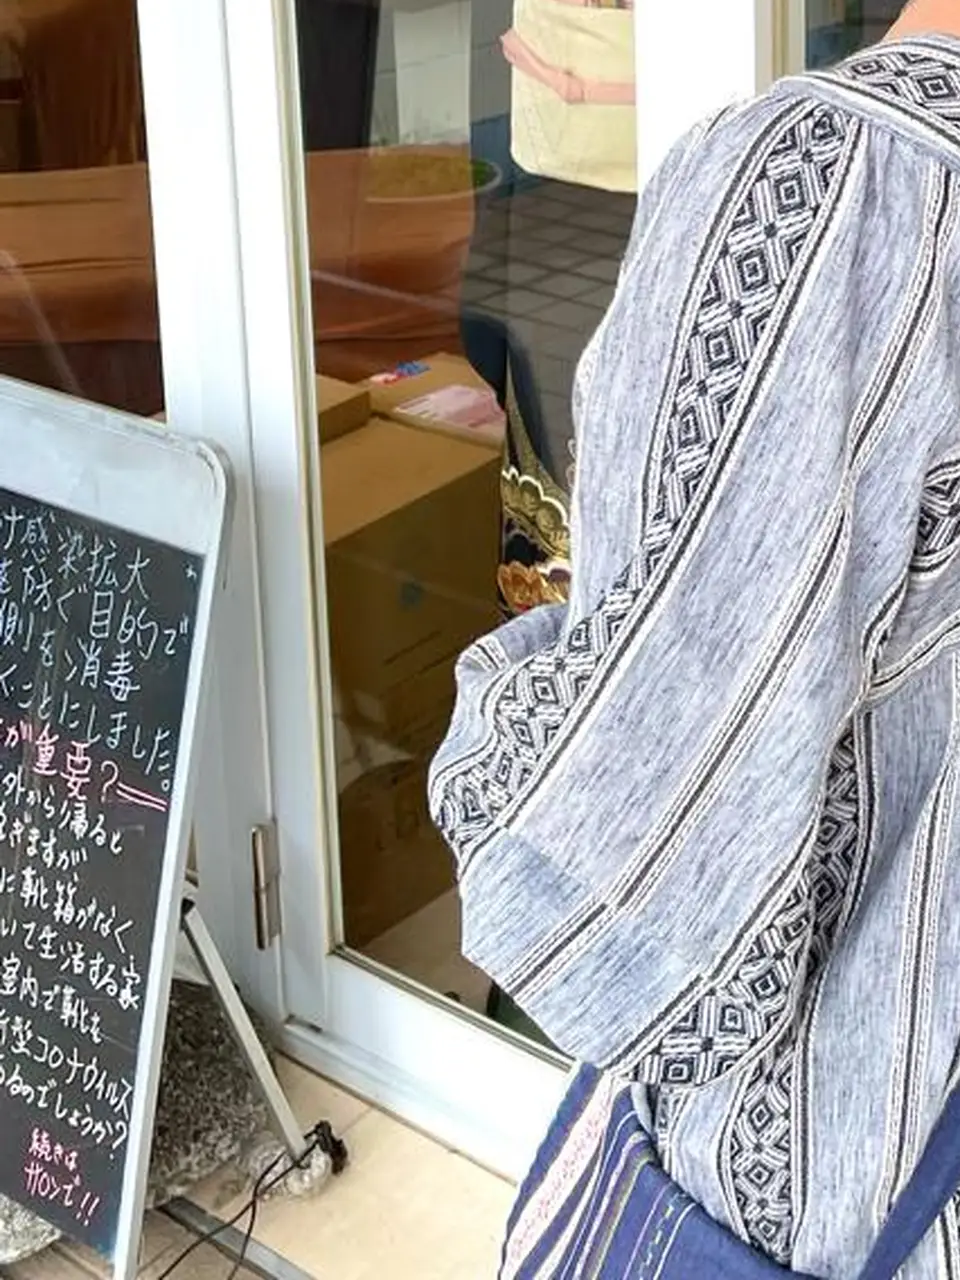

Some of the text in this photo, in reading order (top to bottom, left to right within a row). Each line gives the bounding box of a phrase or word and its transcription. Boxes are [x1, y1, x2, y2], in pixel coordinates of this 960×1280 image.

[0, 1054, 128, 1160] るのでしょうか？
